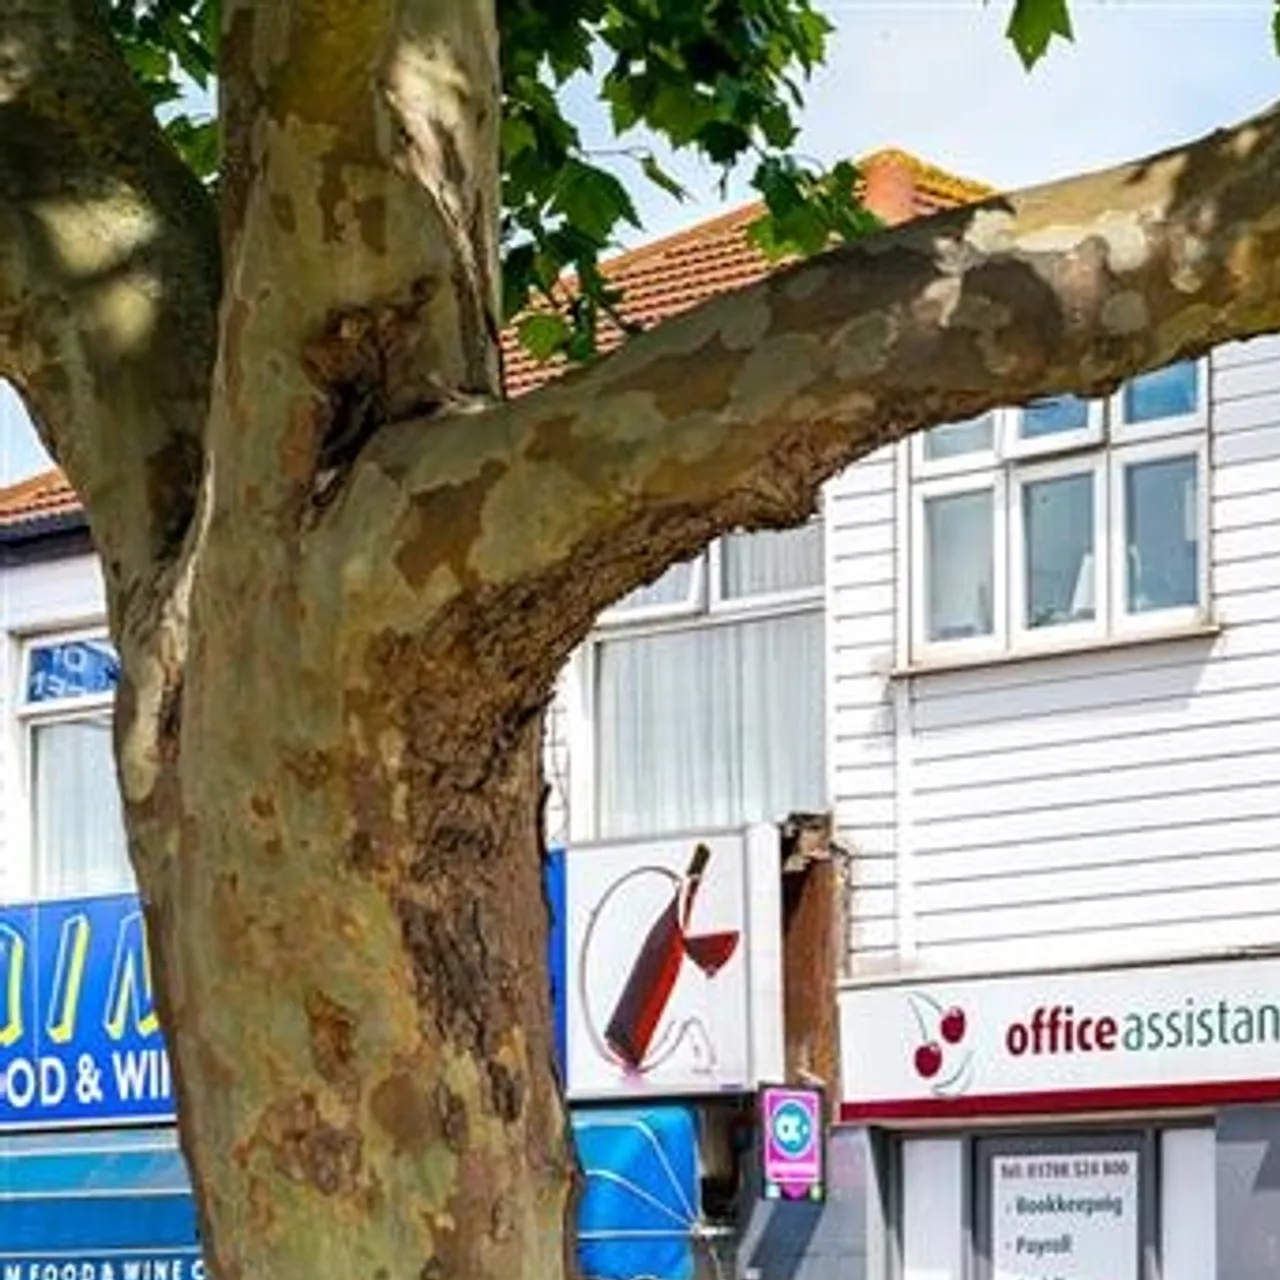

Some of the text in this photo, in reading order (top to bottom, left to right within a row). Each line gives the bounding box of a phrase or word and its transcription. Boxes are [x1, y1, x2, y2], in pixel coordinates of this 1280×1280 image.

[0, 1057, 66, 1107] OD
[77, 1054, 103, 1103] &
[1016, 1193, 1122, 1217] Bookkeeping
[1016, 1234, 1072, 1260] Payroll
